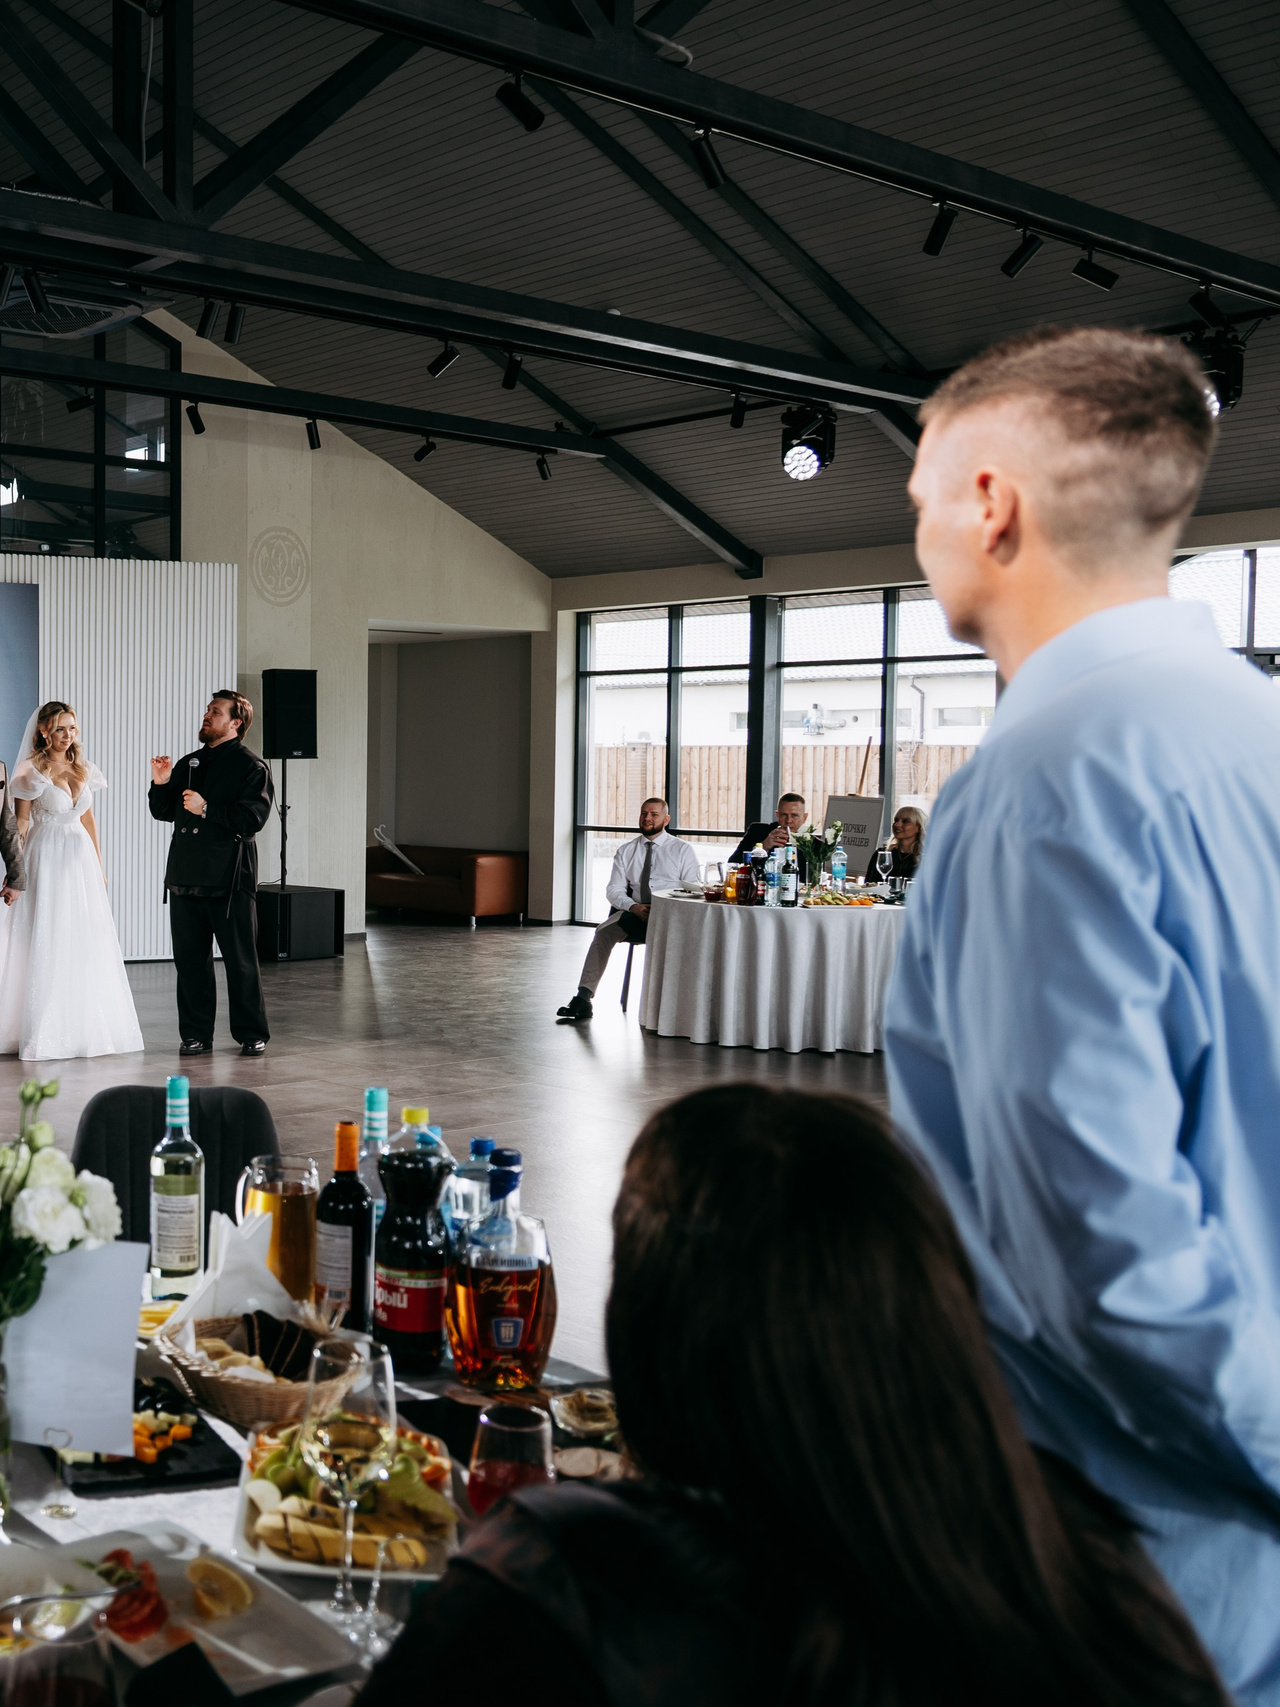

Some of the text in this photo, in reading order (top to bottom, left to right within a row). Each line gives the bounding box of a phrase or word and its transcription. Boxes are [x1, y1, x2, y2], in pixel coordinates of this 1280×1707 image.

[842, 822, 867, 834] ПОЧКИ
[842, 835, 869, 848] ТАНЦЕВ
[375, 1282, 408, 1309] рый
